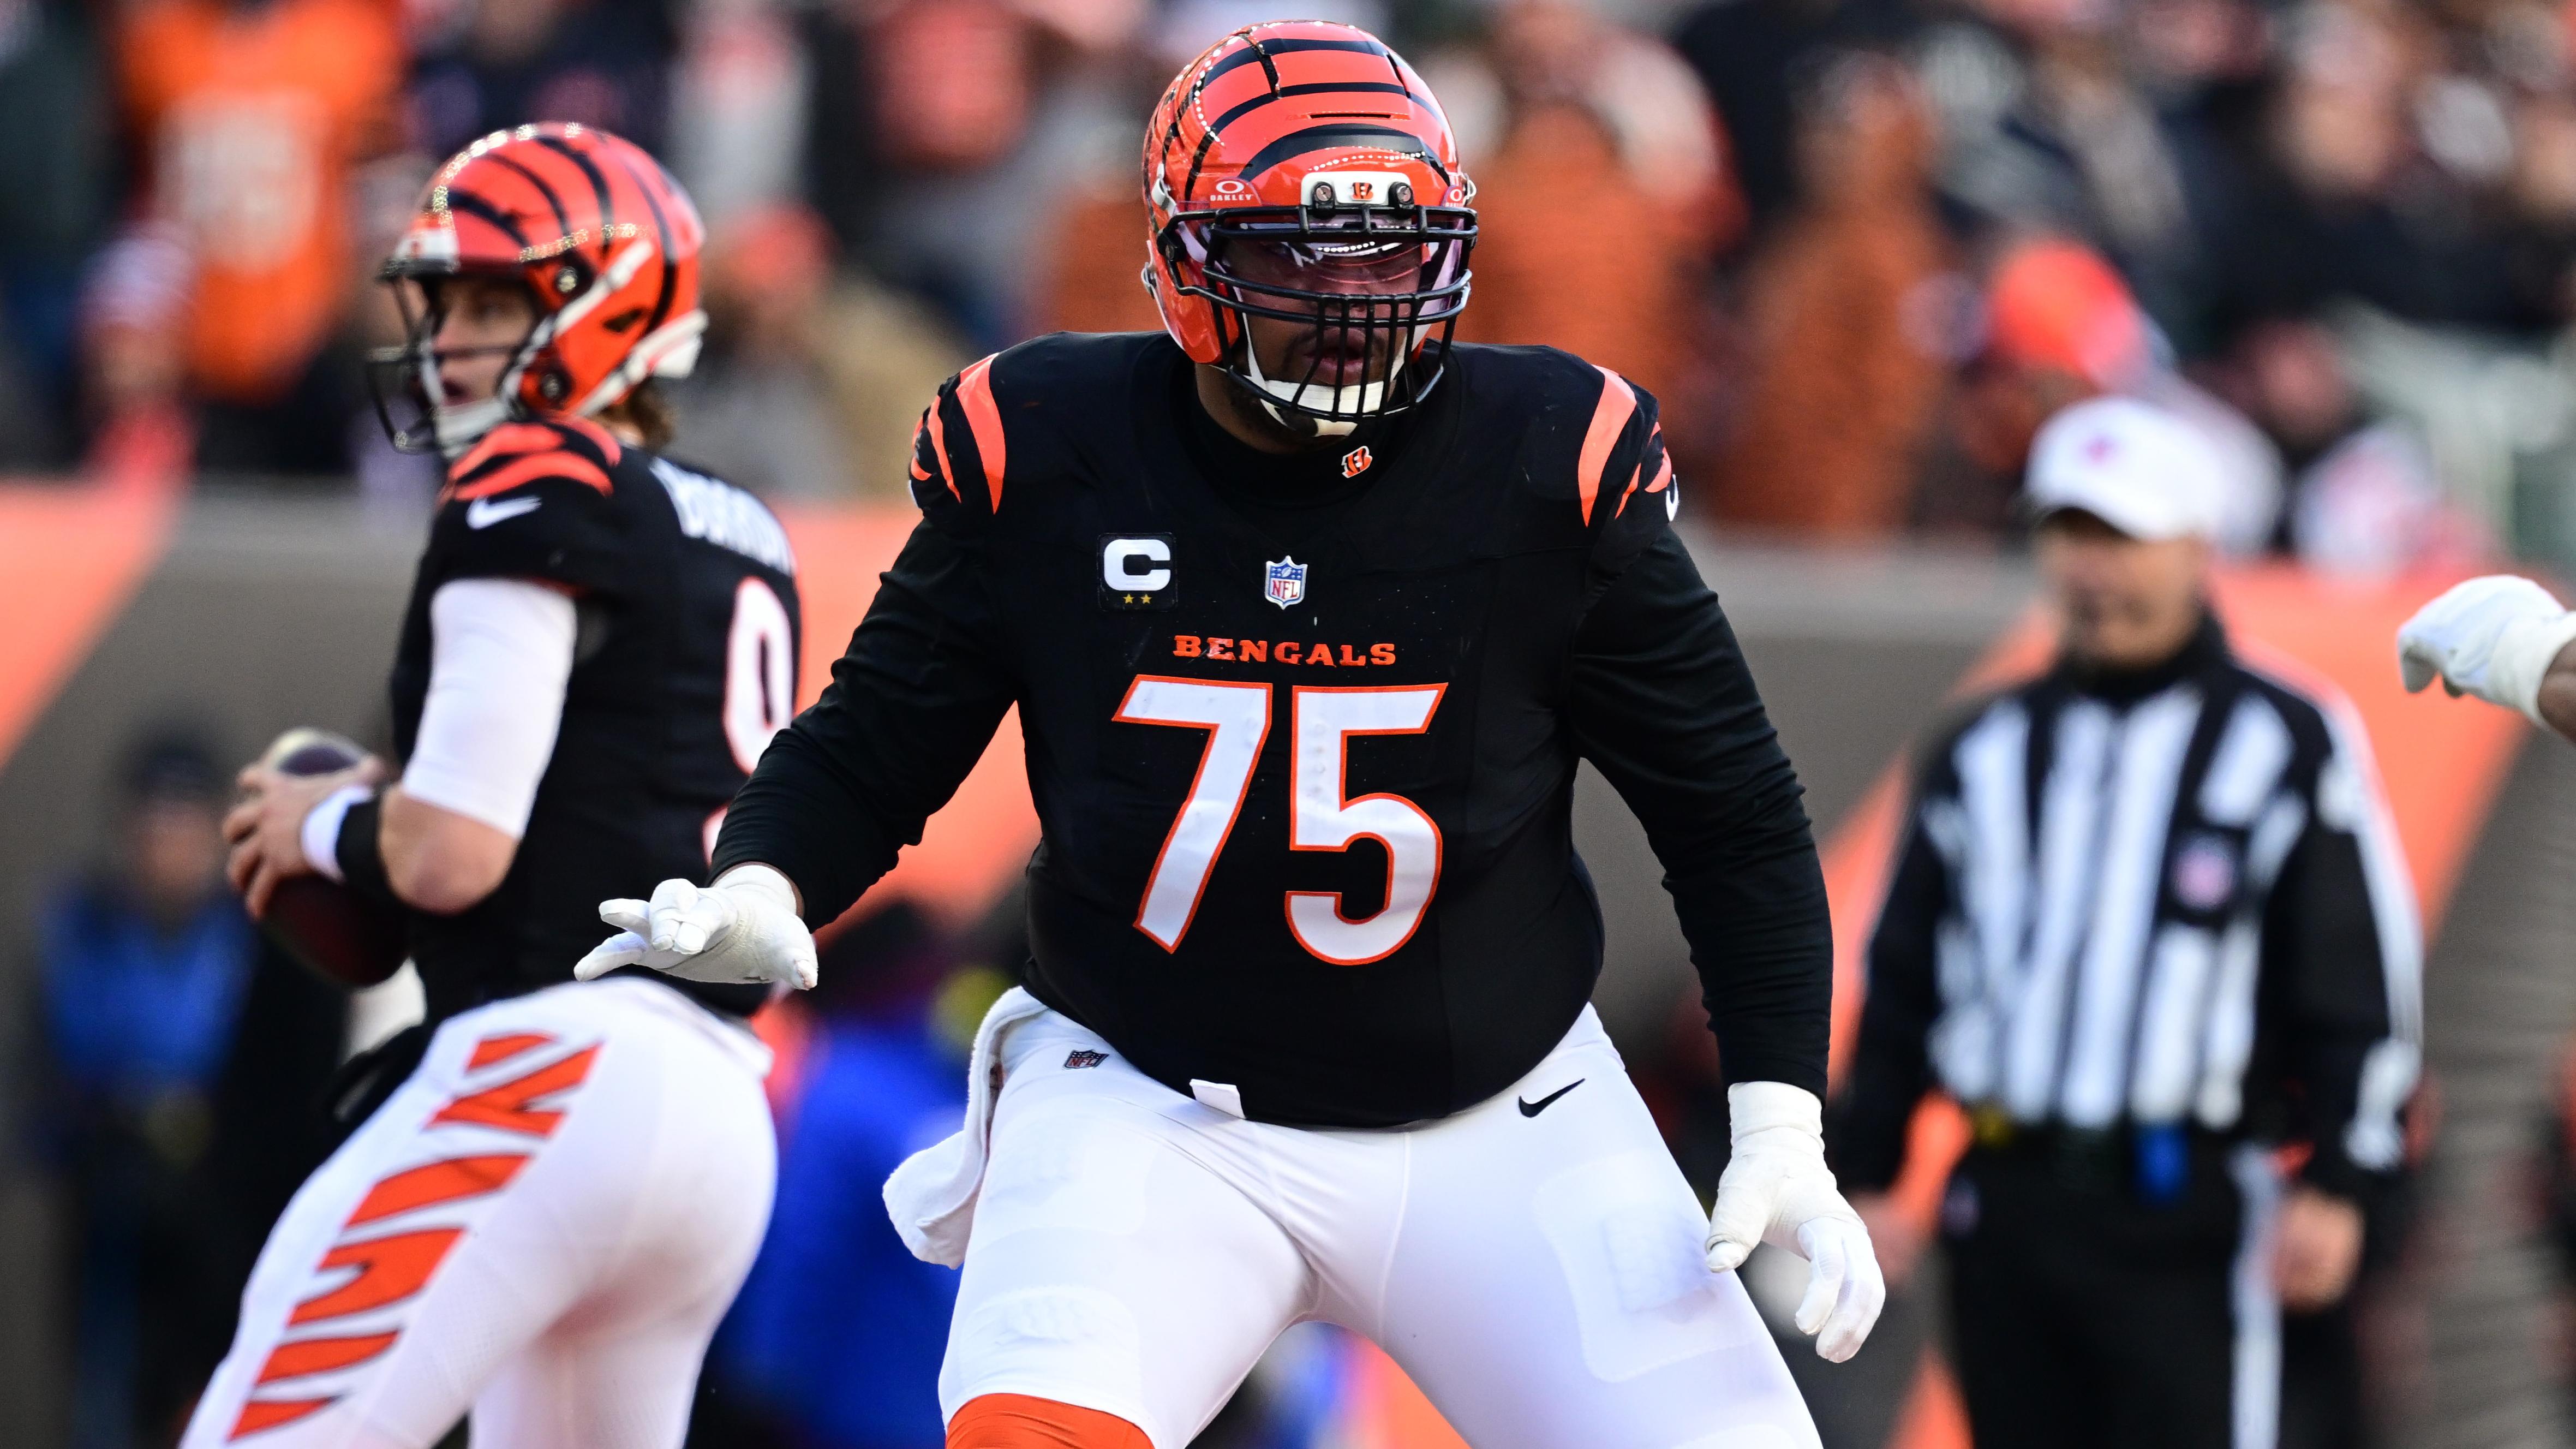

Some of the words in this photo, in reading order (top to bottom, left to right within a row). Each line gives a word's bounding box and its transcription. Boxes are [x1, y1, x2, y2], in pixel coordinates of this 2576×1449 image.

[1103, 539, 1171, 591] C
[1271, 580, 1298, 600] NFL
[1173, 635, 1396, 667] BENGALS
[1111, 674, 1449, 965] 75
[1068, 1057, 1094, 1067] NFL
